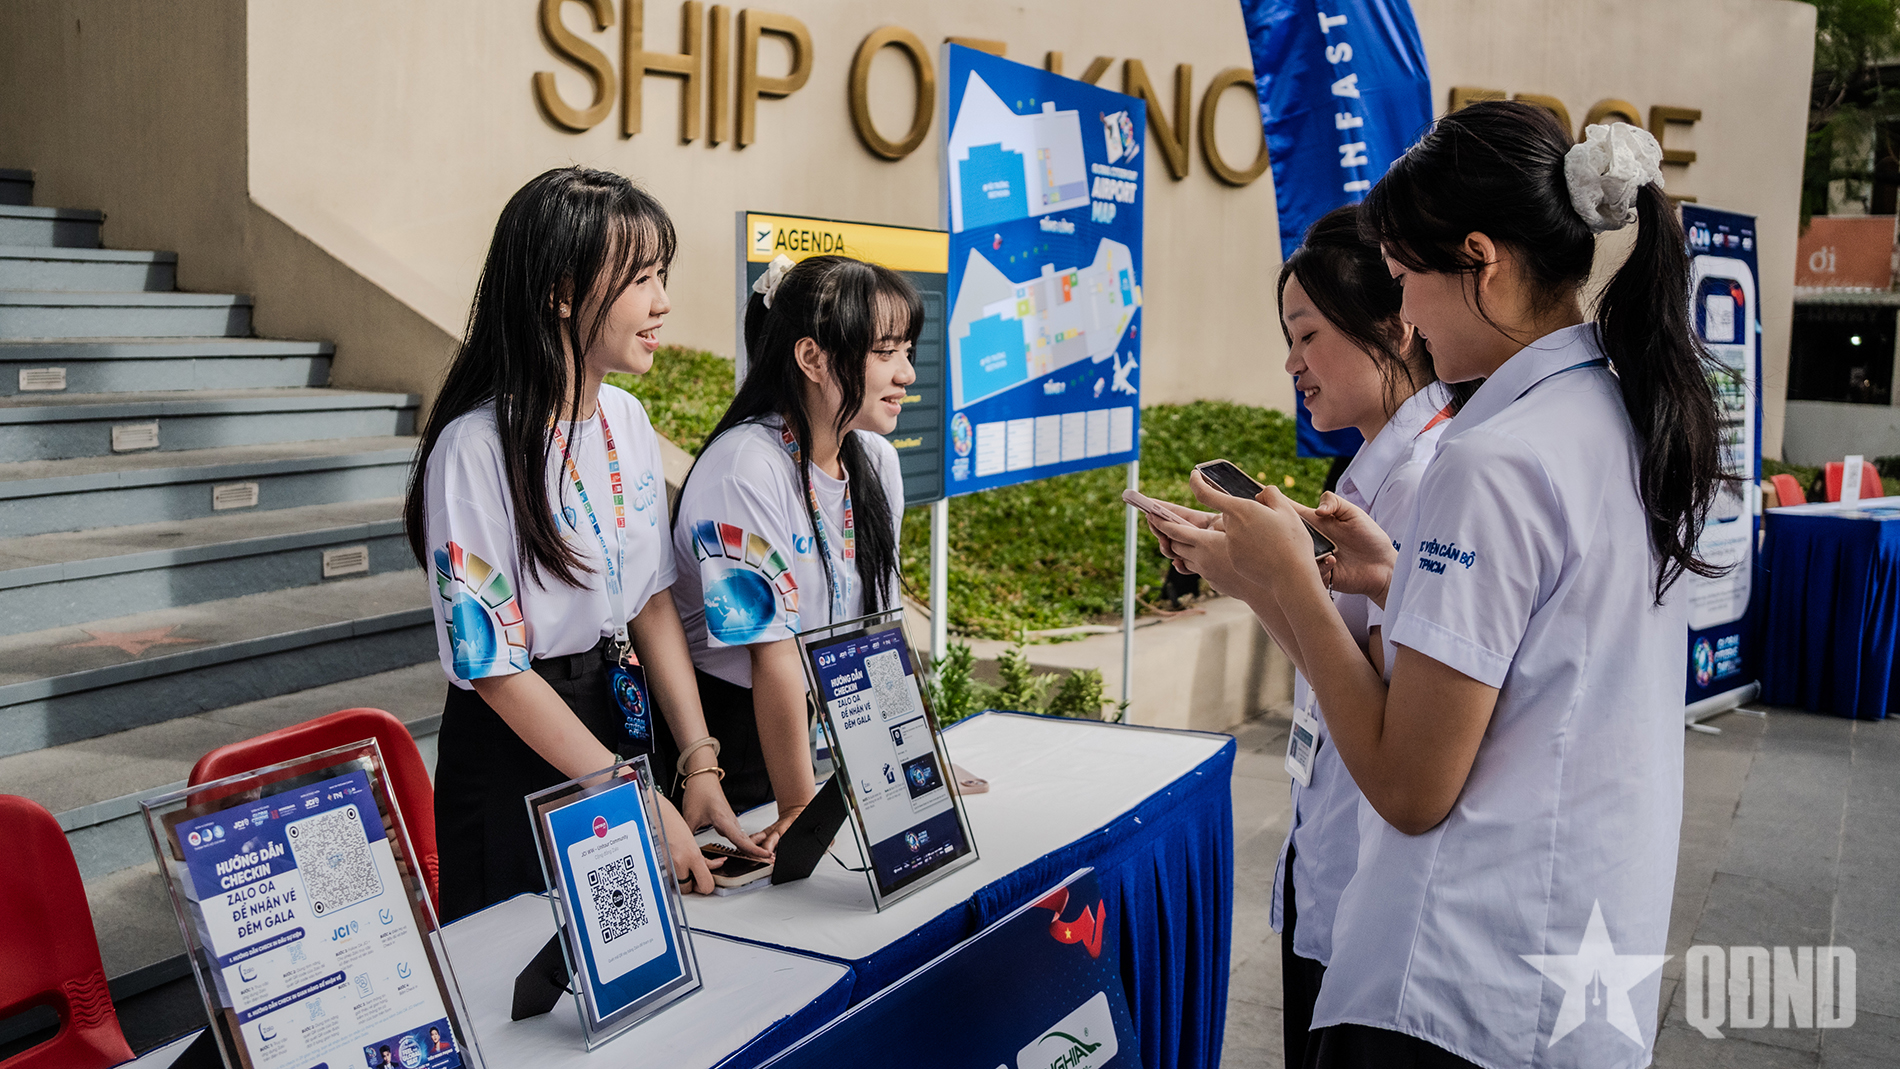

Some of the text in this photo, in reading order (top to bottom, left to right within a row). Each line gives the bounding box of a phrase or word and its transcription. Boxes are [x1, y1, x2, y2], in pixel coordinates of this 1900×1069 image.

[531, 0, 813, 149] SHIP
[1317, 12, 1371, 193] INFAST
[1091, 176, 1137, 204] AIRPORT
[775, 228, 845, 254] AGENDA
[606, 556, 615, 570] JCI
[1440, 542, 1460, 561] CÁN
[1459, 550, 1476, 569] BỘ
[1419, 557, 1446, 575] TPHCM
[831, 669, 863, 687] HƯỚNG DẪN
[834, 683, 857, 696] CHECKIN
[838, 694, 860, 708] ZALO OA
[841, 702, 871, 718] ĐỂ NHẬN VÉ
[844, 715, 871, 730] ĐÊM GALA
[233, 820, 245, 829] JCI
[610, 835, 628, 845] Community
[215, 842, 284, 876] HƯỚNG DẪN
[221, 864, 270, 888] CHECKIN
[227, 881, 275, 905] ZALO OA
[233, 888, 296, 922] ĐỂ NHẬN VÉ
[238, 910, 294, 938] ĐÊM GALA
[332, 925, 350, 941] JCI
[243, 967, 254, 975] Zalo
[263, 1026, 274, 1034] Zalo
